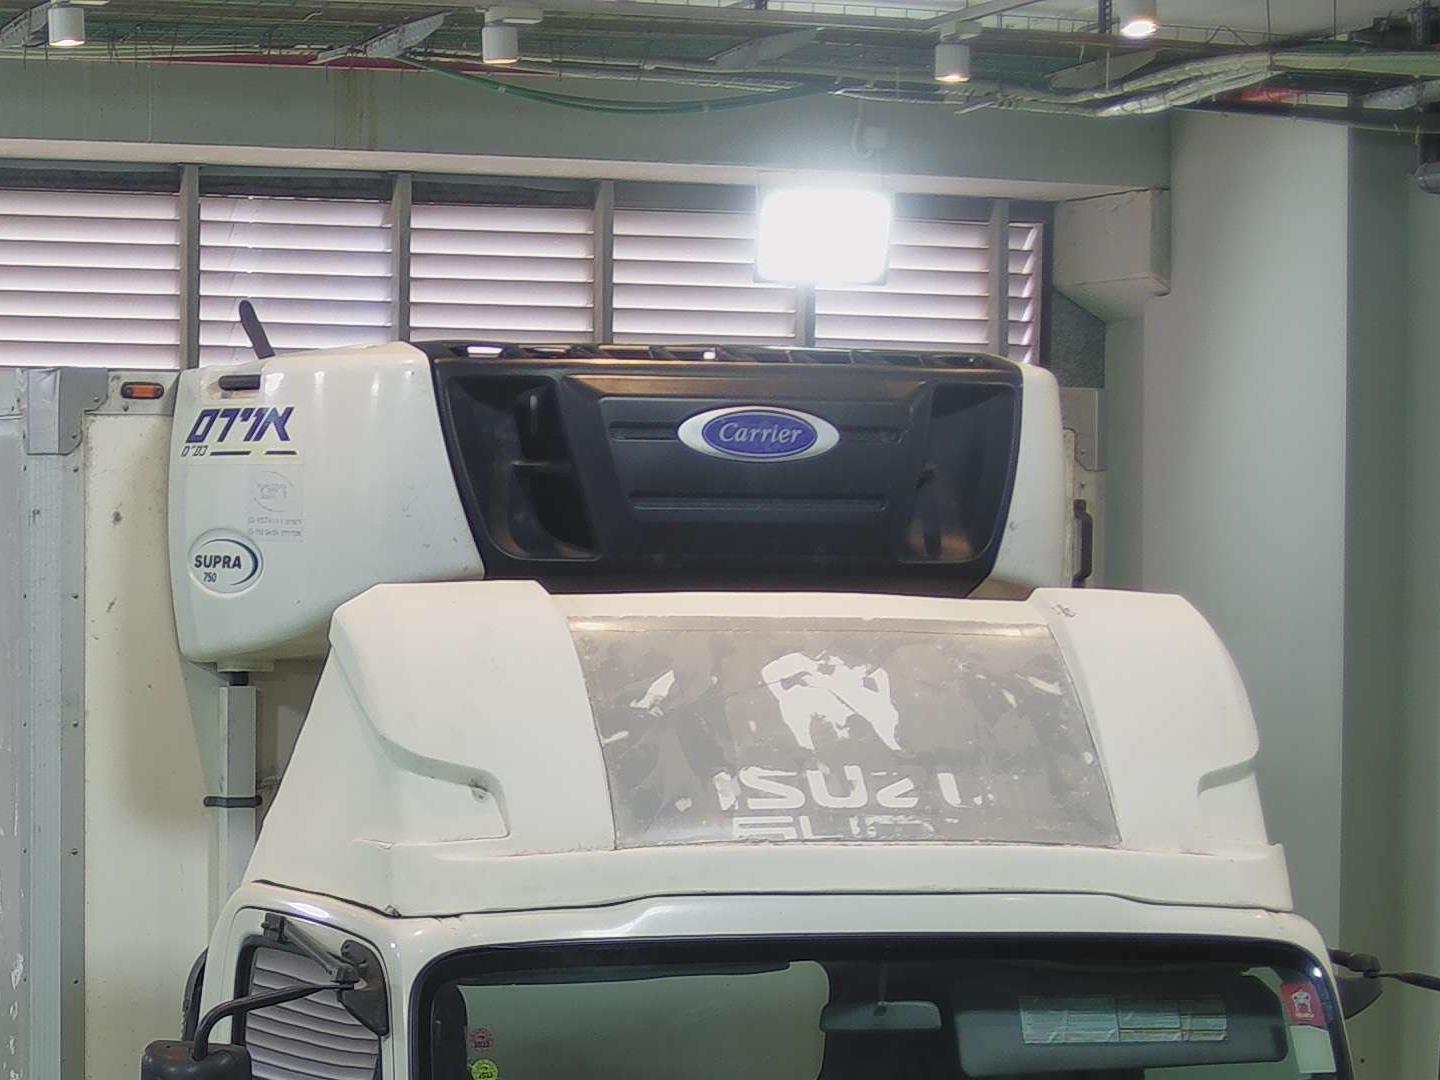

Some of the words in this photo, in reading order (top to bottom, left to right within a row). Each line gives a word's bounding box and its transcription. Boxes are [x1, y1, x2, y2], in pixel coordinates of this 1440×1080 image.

[718, 421, 803, 444] Carrier
[194, 554, 242, 569] SUPRA
[203, 572, 217, 583] 750
